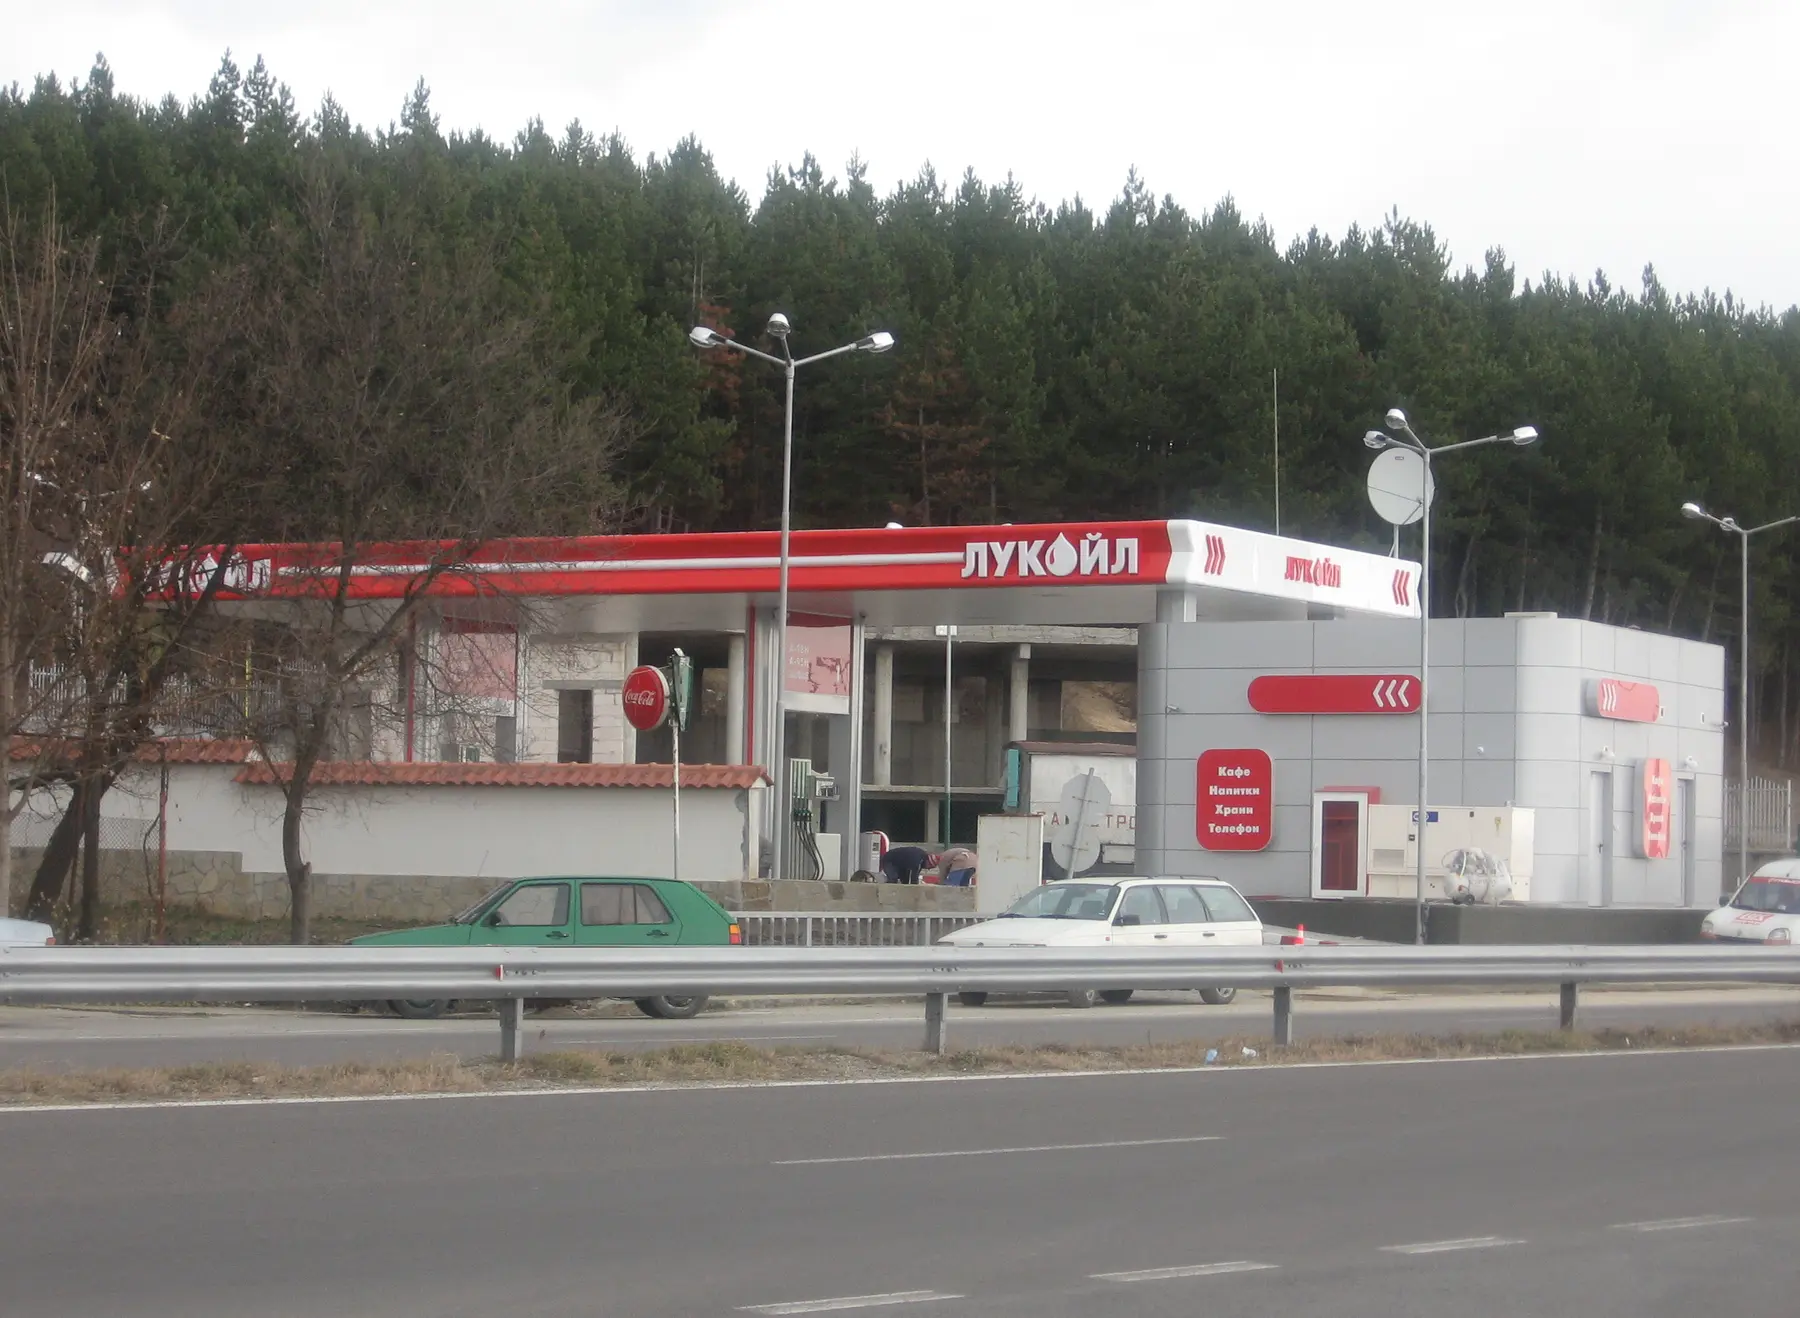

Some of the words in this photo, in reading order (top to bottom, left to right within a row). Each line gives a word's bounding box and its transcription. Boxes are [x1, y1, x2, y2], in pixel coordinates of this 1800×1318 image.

[961, 532, 1139, 578] ЛУКОЙЛ
[1284, 556, 1342, 588] ЛУКОЙЛ
[1218, 766, 1251, 779] Кафе
[1209, 785, 1260, 796] Напитки
[1215, 804, 1254, 817] Храни
[1208, 823, 1260, 836] Телефон
